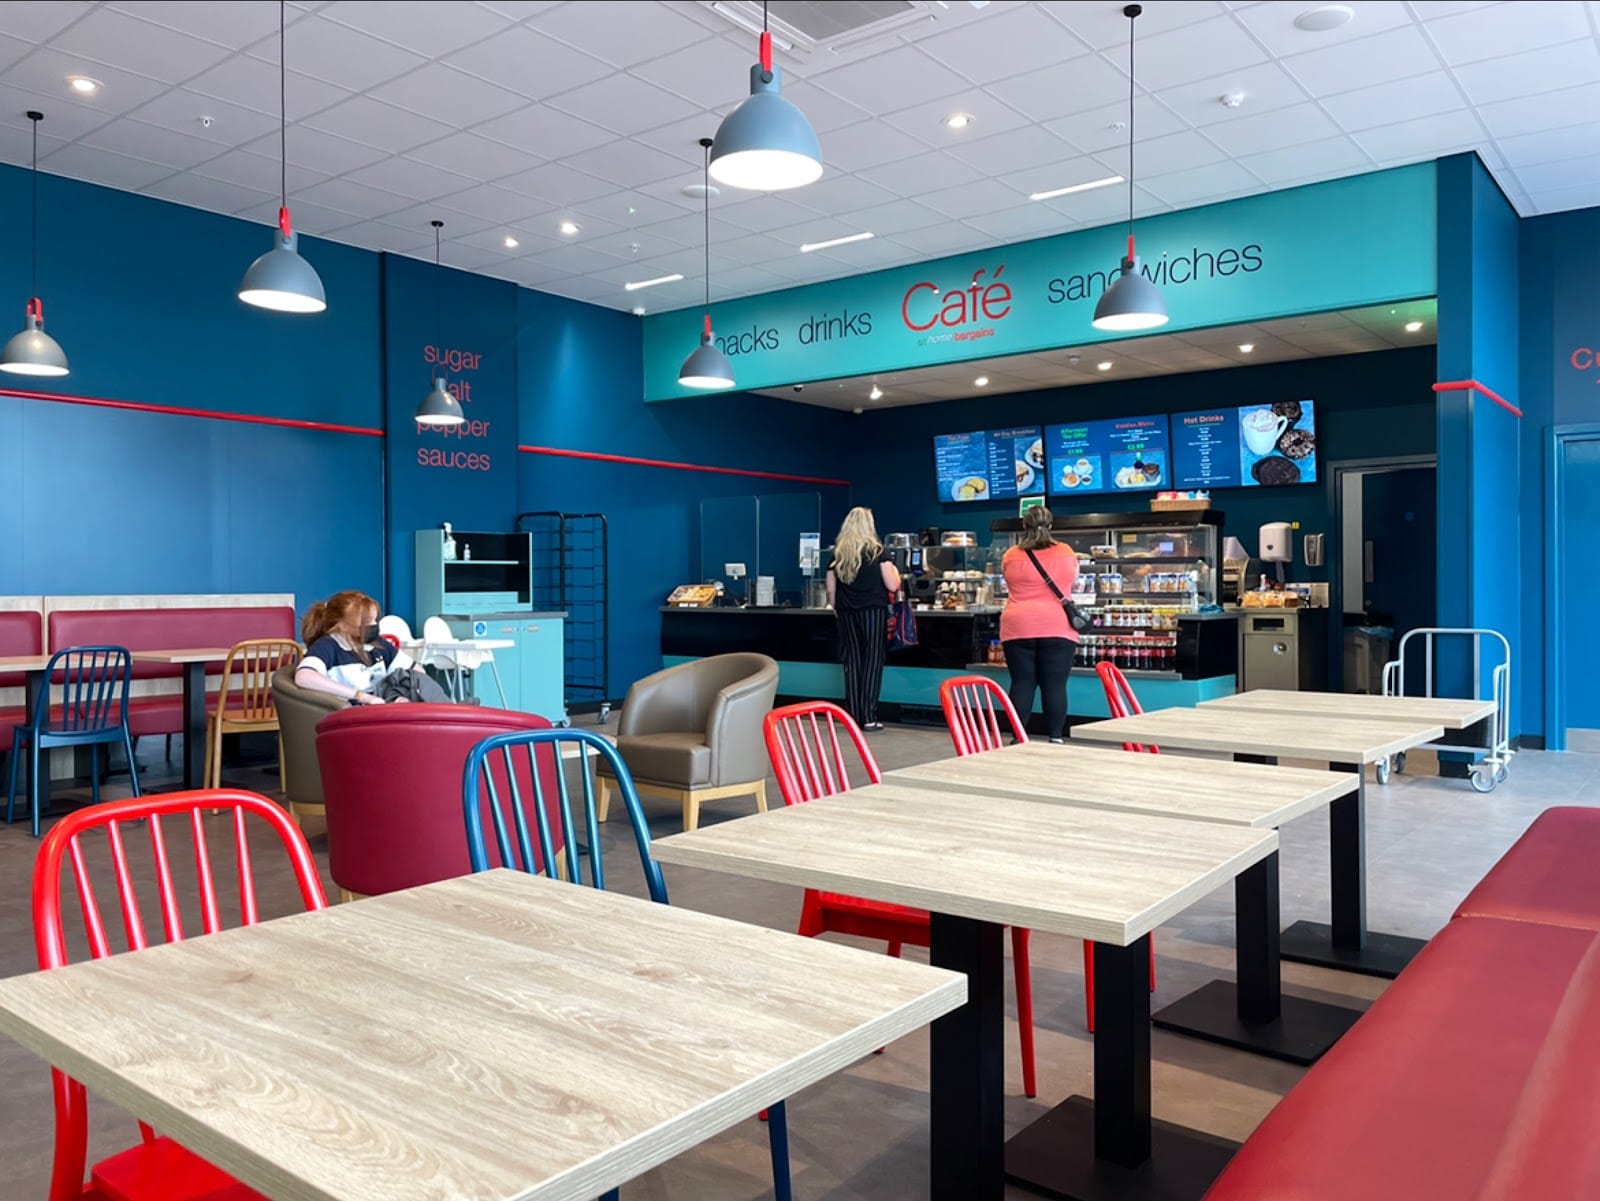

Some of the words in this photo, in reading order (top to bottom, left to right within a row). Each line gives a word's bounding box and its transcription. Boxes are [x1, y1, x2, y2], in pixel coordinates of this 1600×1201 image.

[713, 324, 780, 356] nacks
[798, 308, 873, 345] drinks
[901, 264, 1013, 332] Café
[928, 334, 953, 345] home
[954, 328, 995, 342] bargains
[423, 344, 482, 373] sugar
[448, 379, 472, 403] alt
[1183, 416, 1198, 425] Hot
[1199, 415, 1225, 424] Drinks
[417, 447, 491, 471] sauces
